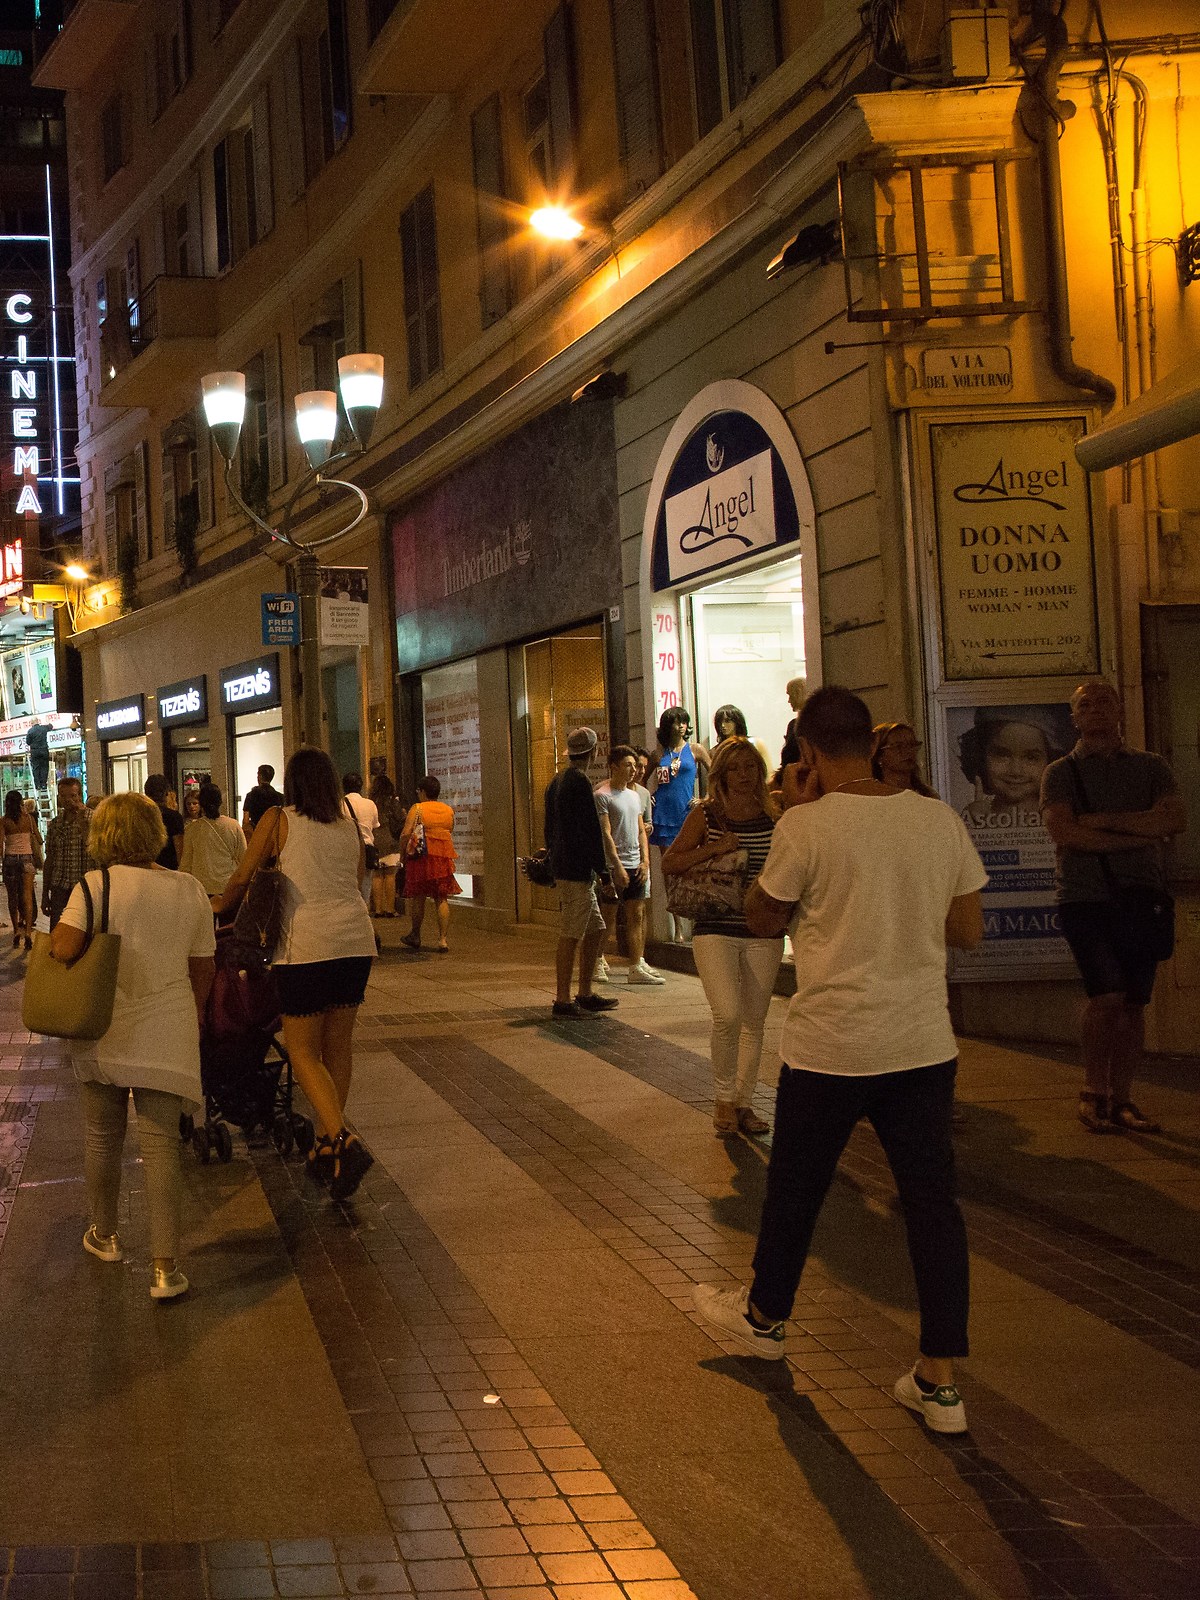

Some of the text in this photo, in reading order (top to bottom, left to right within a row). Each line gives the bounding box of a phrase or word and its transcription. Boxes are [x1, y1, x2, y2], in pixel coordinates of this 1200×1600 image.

[950, 354, 984, 368] VIA
[927, 372, 1010, 389] DEL VOLTURNO
[6, 293, 42, 514] CINEMA
[954, 457, 1069, 508] Angel
[680, 475, 756, 552] Angel
[960, 523, 1070, 547] DONNA
[442, 527, 512, 597] Timberland
[971, 550, 1062, 574] UOMO
[959, 587, 1008, 599] FEMME
[1024, 584, 1077, 596] HOMME
[968, 602, 1022, 613] WOMAN
[1037, 600, 1069, 611] MAN
[1057, 635, 1081, 646] 202
